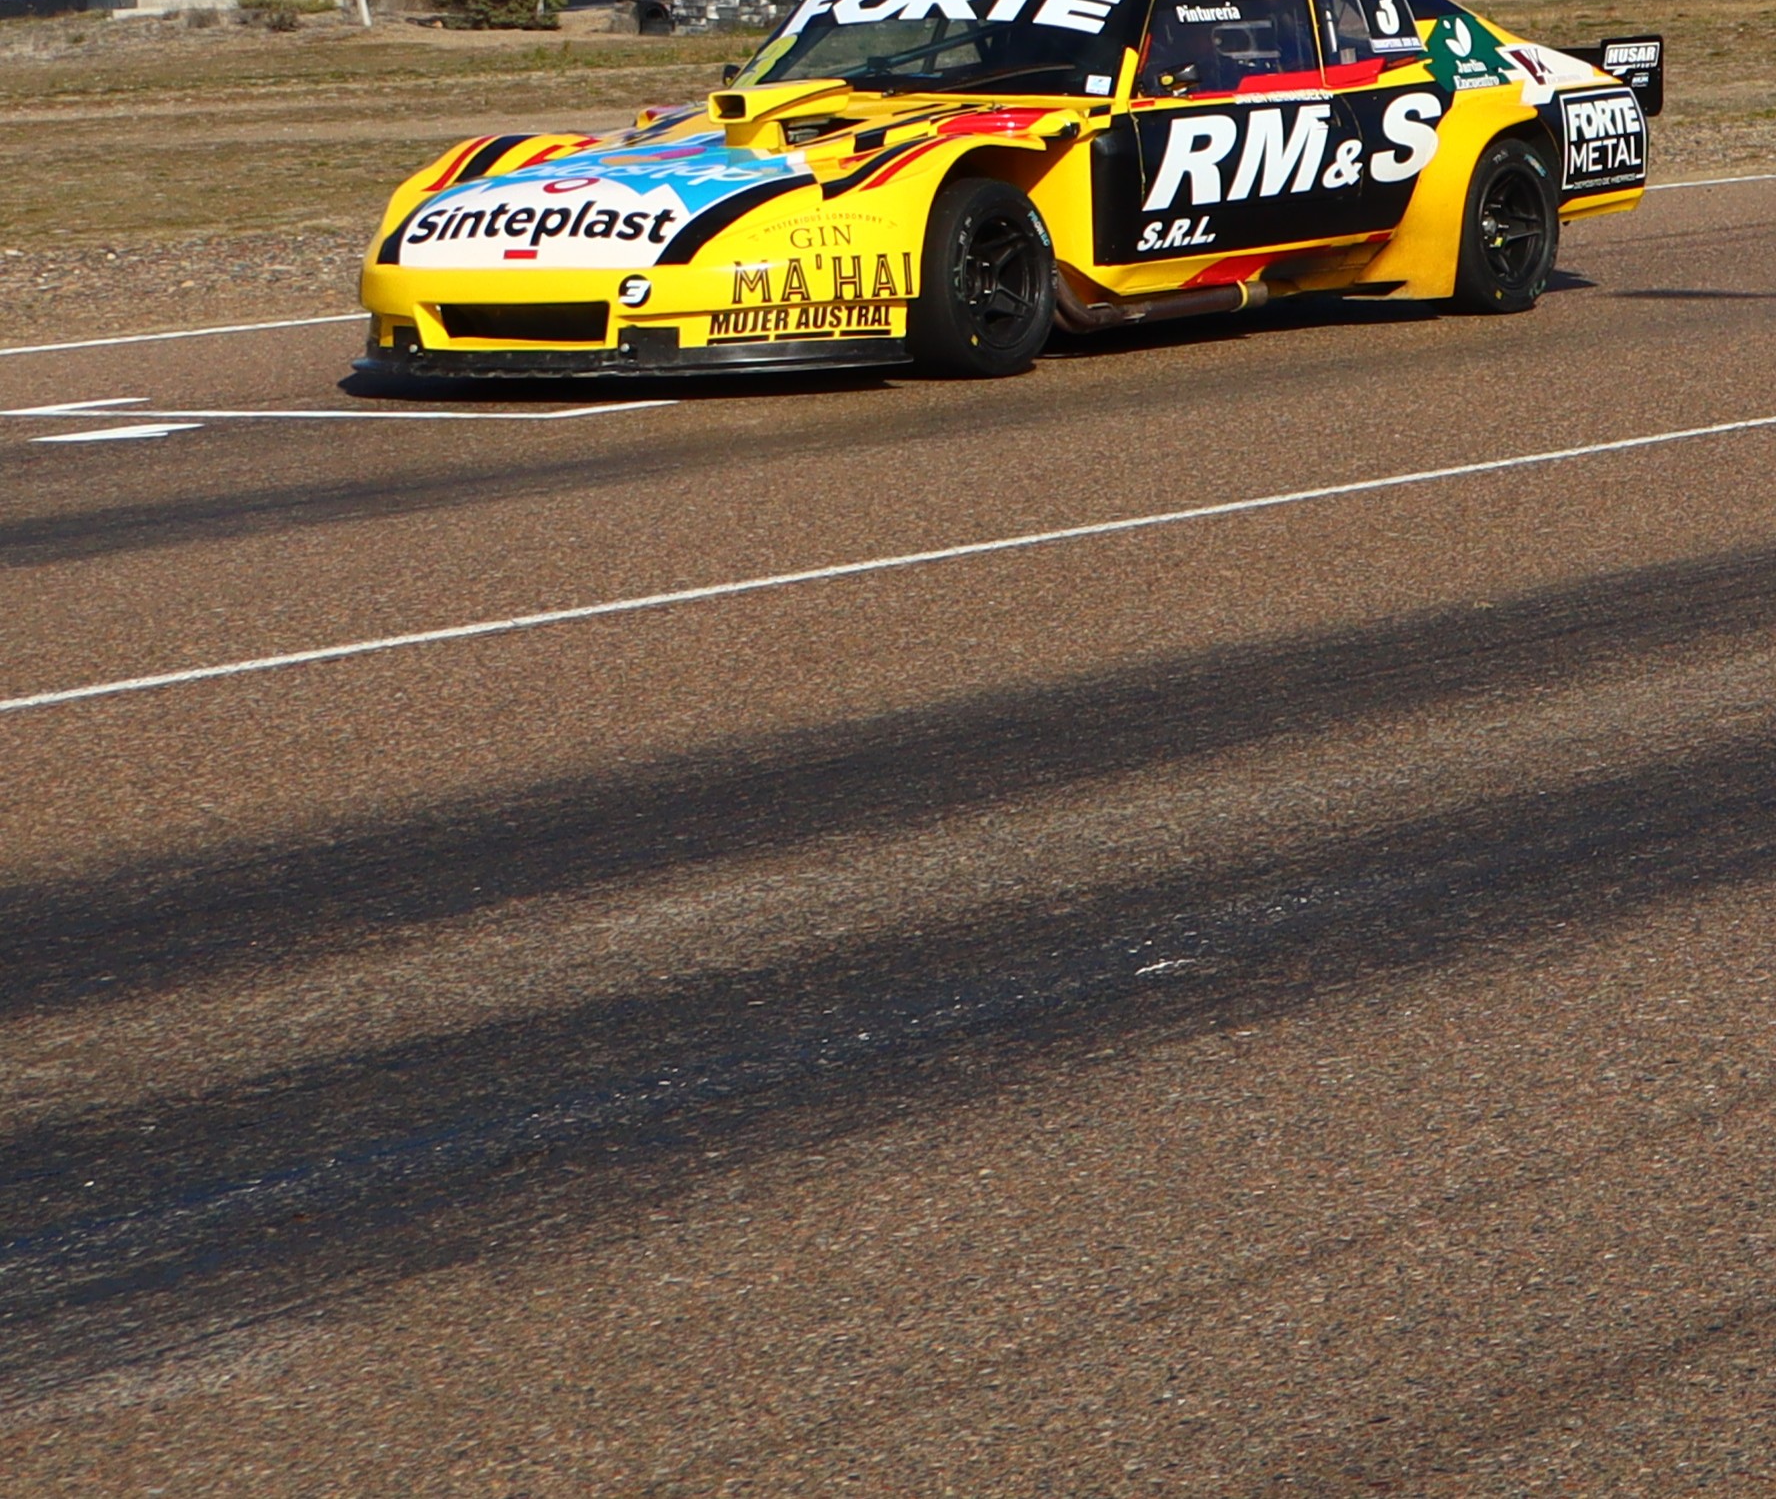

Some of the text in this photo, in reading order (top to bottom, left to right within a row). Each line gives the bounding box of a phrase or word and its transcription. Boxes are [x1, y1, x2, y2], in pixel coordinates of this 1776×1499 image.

[1607, 46, 1656, 63] HUSAR
[1566, 96, 1641, 142] FORTE
[1570, 136, 1641, 175] METAL
[764, 214, 822, 233] MYSTERIOUS
[826, 212, 862, 221] LONDON
[790, 224, 852, 249] GIN
[1136, 216, 1216, 252] S.R.L.
[619, 280, 651, 305] 3
[709, 305, 891, 336] MUJER AUSTRAL
